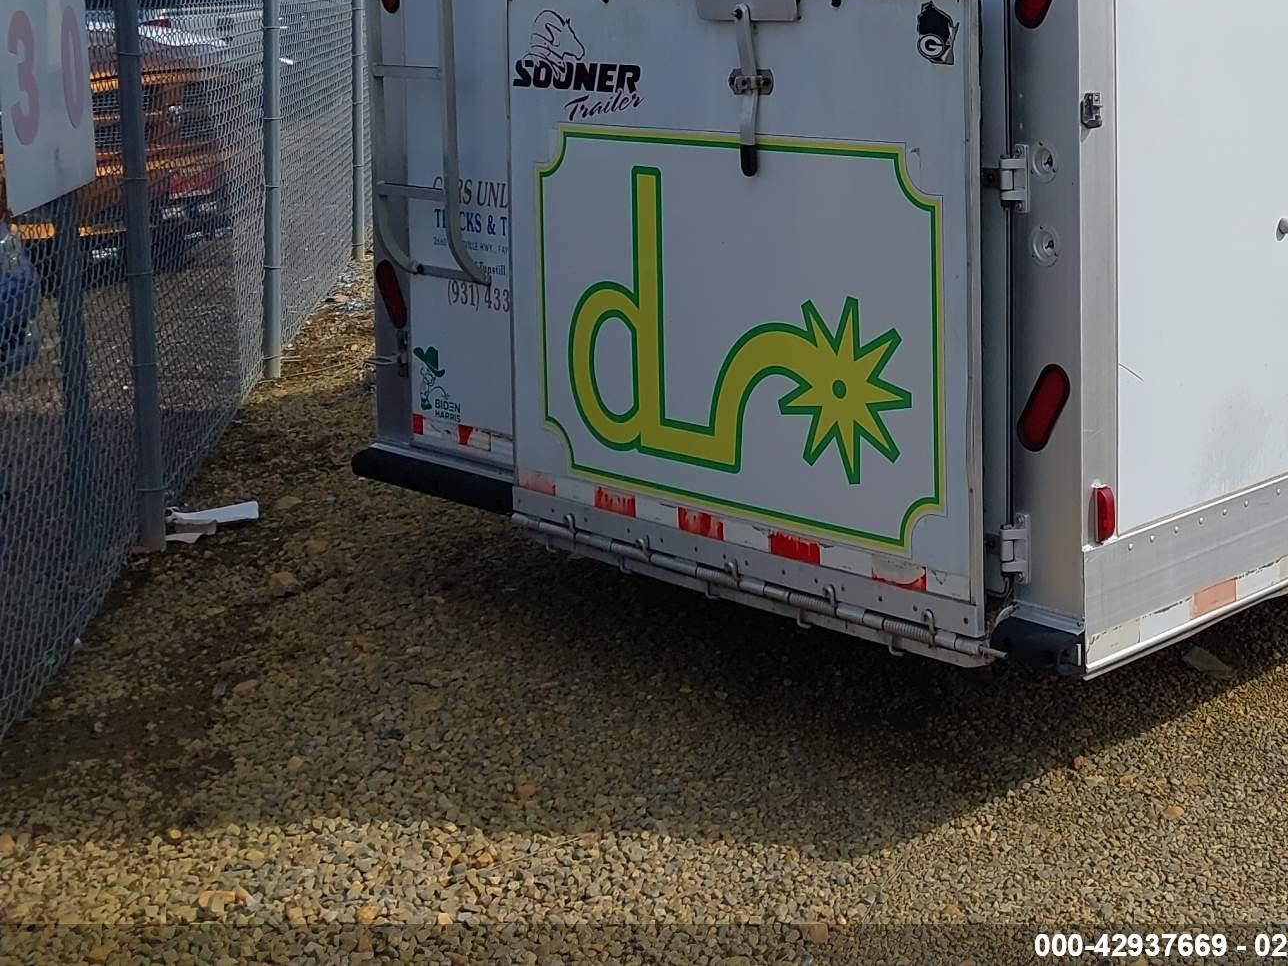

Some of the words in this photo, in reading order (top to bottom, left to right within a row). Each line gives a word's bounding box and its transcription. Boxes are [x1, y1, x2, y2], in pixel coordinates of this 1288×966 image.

[512, 59, 641, 94] SOONER
[564, 90, 644, 121] Trailer
[487, 214, 497, 235] &
[434, 398, 461, 413] BIDEN
